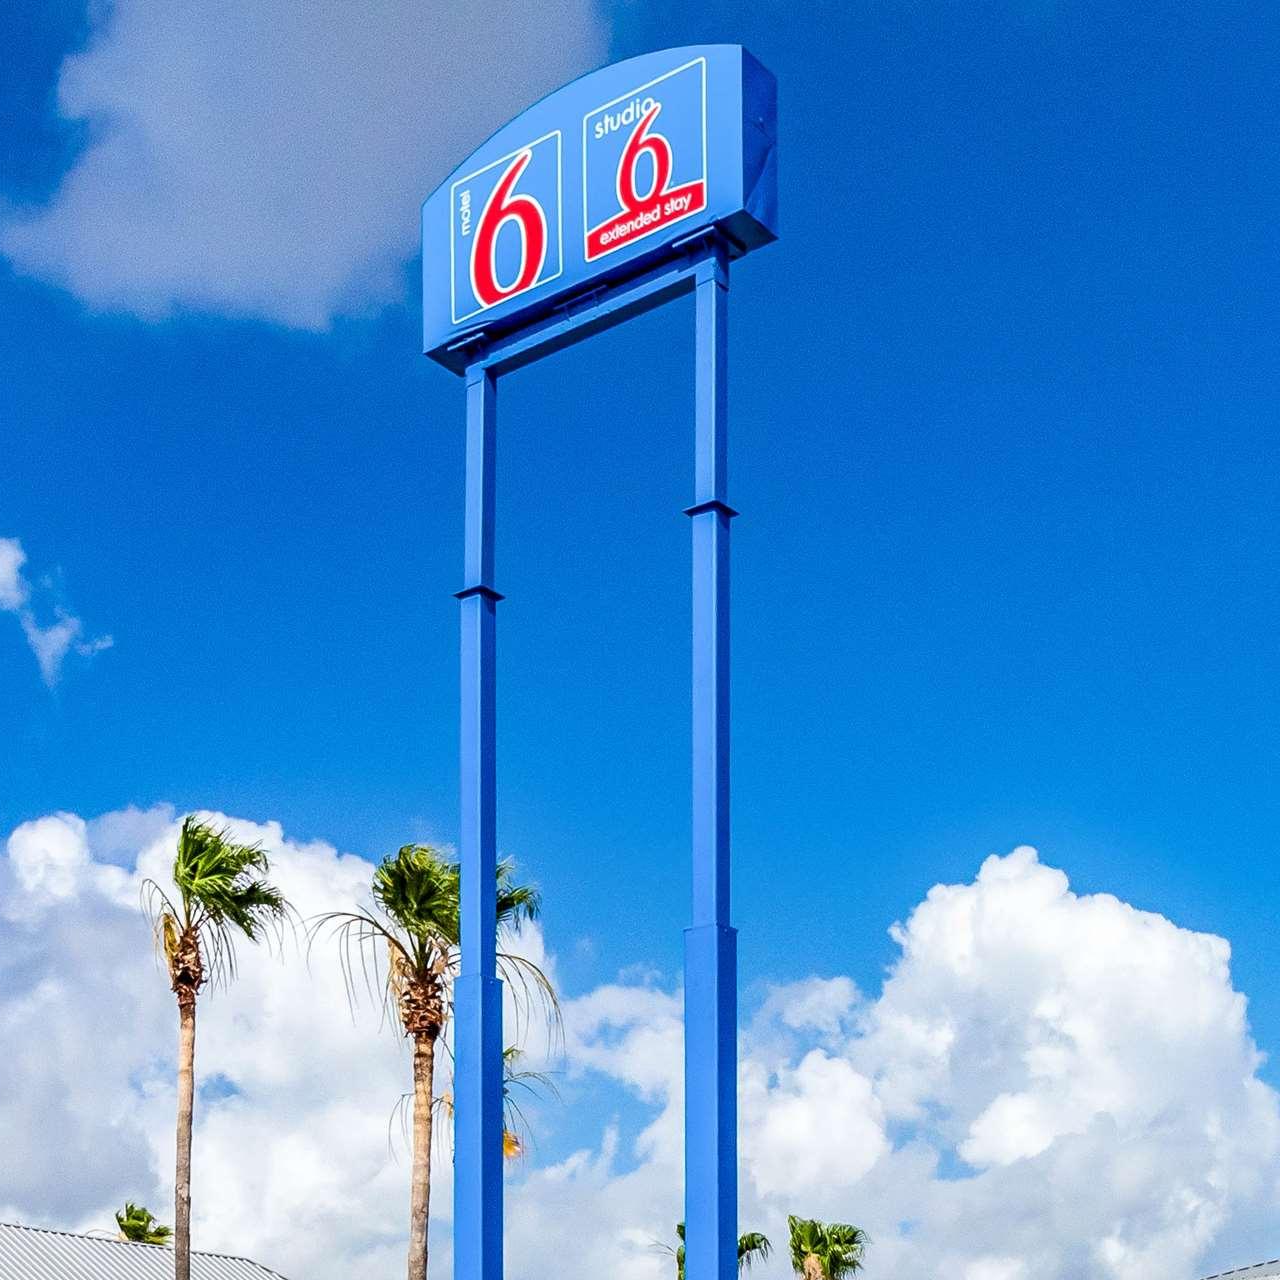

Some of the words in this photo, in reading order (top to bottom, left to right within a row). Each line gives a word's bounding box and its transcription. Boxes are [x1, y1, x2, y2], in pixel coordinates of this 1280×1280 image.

[594, 97, 655, 139] studio
[616, 102, 673, 212] 6
[459, 190, 470, 236] motel
[470, 148, 548, 309] 6
[599, 203, 662, 246] extended
[663, 193, 693, 217] stay
